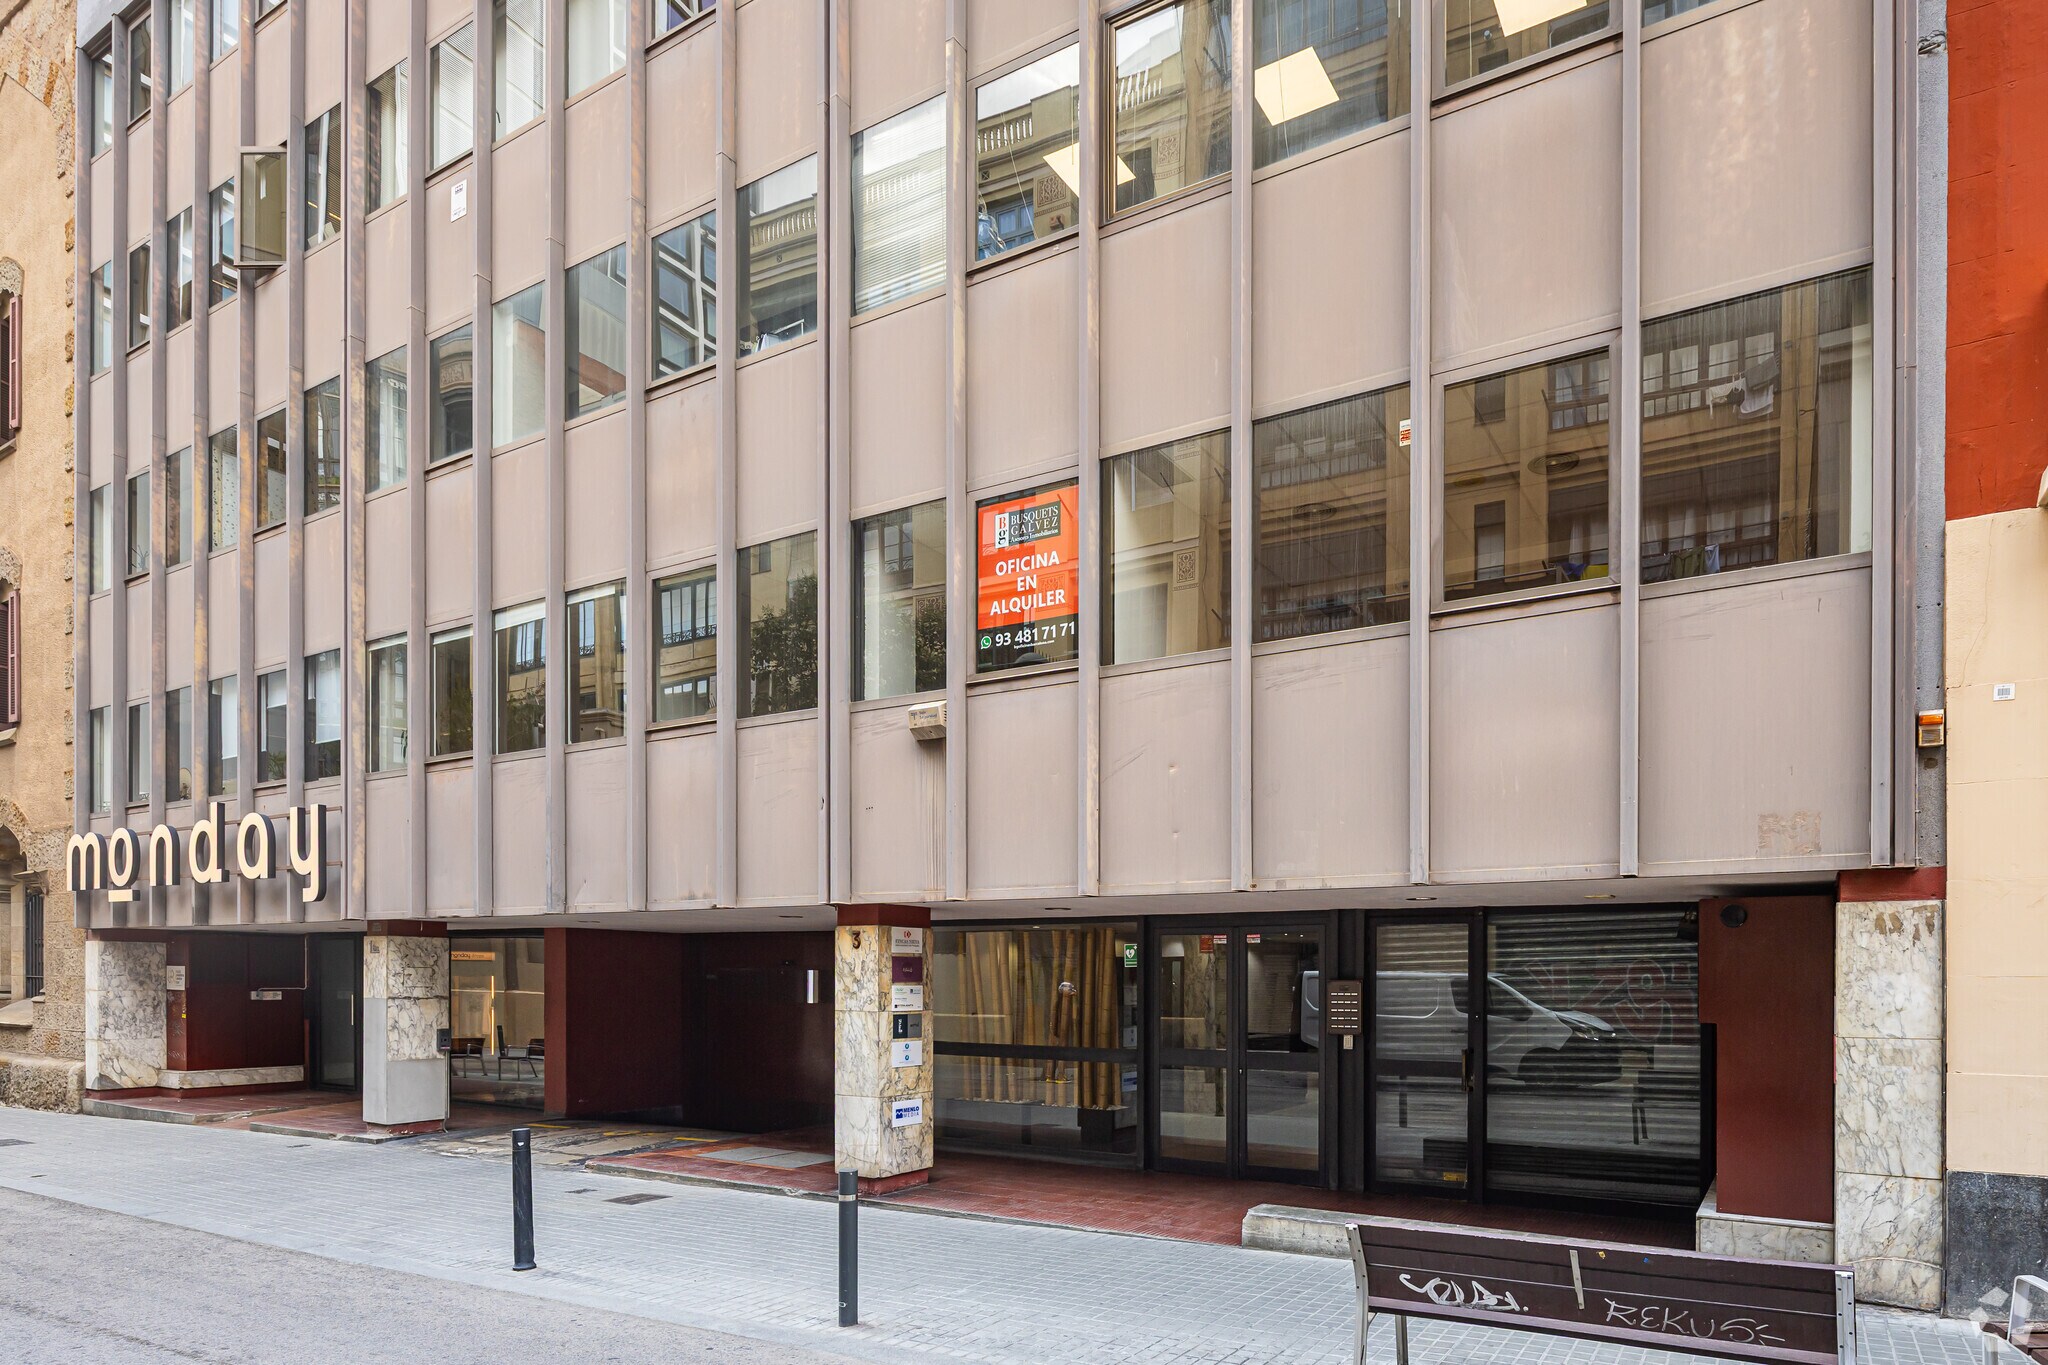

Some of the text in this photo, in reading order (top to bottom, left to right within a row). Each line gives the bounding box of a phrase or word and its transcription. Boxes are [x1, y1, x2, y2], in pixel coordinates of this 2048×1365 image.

[1011, 505, 1059, 525] BUSQUETS
[1011, 516, 1058, 535] GALVEZ
[995, 550, 1060, 576] OFICINA
[1017, 574, 1037, 592] EN
[990, 589, 1066, 616] ALQUILER
[995, 621, 1075, 646] 93 481 71 71
[66, 801, 327, 903] monday
[852, 930, 861, 949] 3
[903, 1105, 920, 1113] MENLO
